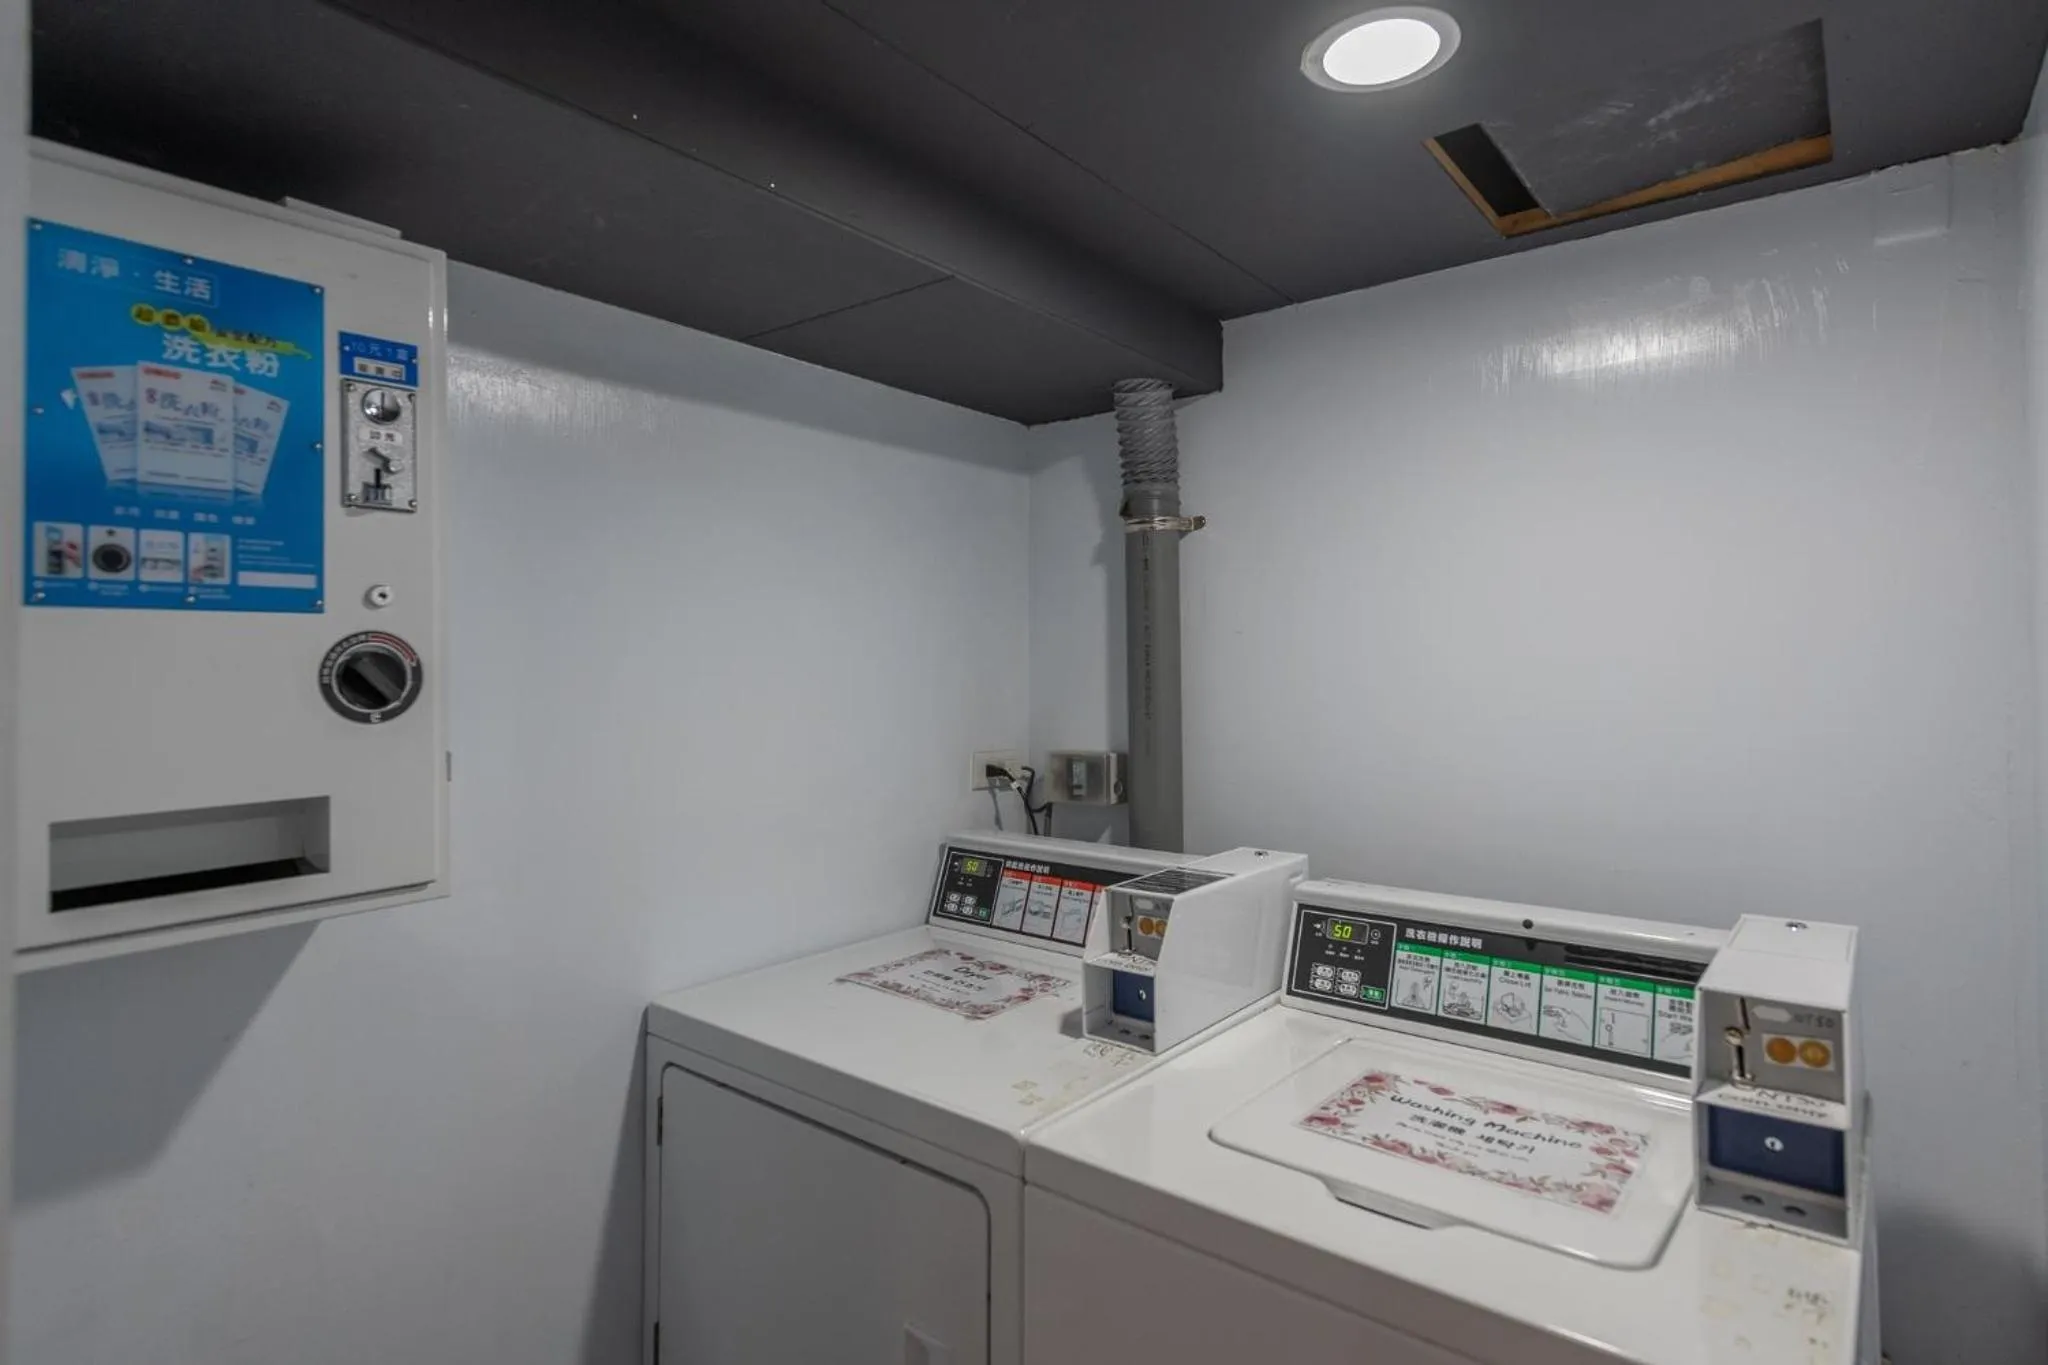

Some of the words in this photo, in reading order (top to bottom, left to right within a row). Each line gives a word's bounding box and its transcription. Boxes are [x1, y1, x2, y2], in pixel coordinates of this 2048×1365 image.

[153, 269, 213, 300] 生活
[161, 332, 280, 377] 洗衣粉
[1333, 924, 1352, 939] 50
[1389, 1094, 1477, 1127] Washing
[1483, 1121, 1582, 1149] Machine
